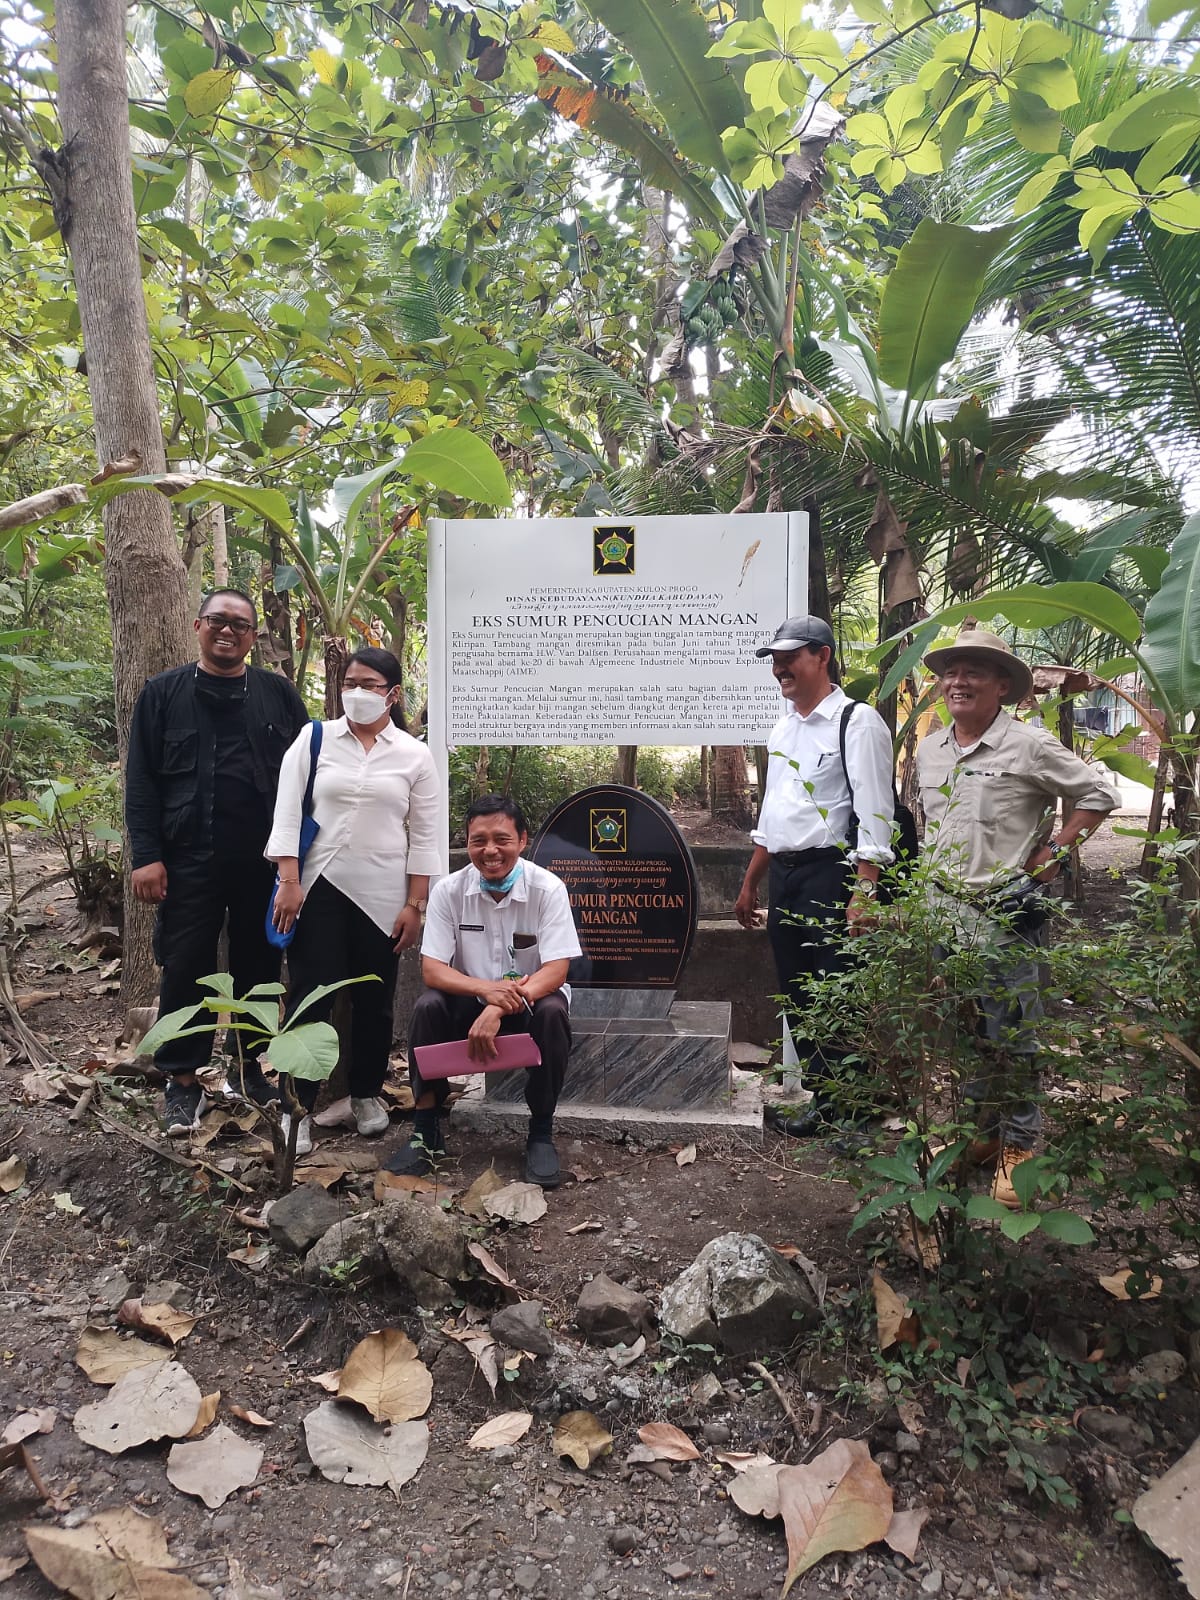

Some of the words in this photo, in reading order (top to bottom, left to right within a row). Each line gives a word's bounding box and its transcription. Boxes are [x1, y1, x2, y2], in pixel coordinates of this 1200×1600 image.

[472, 616, 502, 627] EKS
[507, 615, 568, 627] SUMUR
[573, 614, 673, 627] PENCUCIAN
[679, 613, 758, 626] MANGAN
[498, 631, 537, 639] Pencucian
[541, 631, 572, 640] Mangan
[576, 631, 621, 640] merupakan
[624, 630, 652, 639] bagian
[655, 630, 693, 639] tinggalan
[696, 630, 733, 639] tambang
[736, 631, 770, 639] mangan
[493, 640, 530, 650] Tambang
[536, 641, 569, 650] mangan
[628, 640, 647, 648] pada
[653, 639, 676, 647] bulan
[682, 639, 700, 648] Juni
[452, 650, 494, 659] pengusaha
[664, 648, 710, 657] mengalami
[452, 659, 470, 668] pada
[559, 658, 584, 666] bawah
[589, 658, 635, 667] Algemeene
[690, 658, 730, 667] Mijnbouw
[736, 657, 773, 667] Exploitat
[452, 668, 504, 677] Maatschappij
[550, 685, 582, 694] Mangan
[588, 685, 633, 694] merupakan
[689, 685, 716, 693] bagian
[722, 684, 748, 692] dalam
[754, 686, 780, 694] proses
[452, 695, 486, 703] produksi
[627, 694, 663, 703] tambang
[667, 695, 700, 703] mangan
[452, 704, 509, 713] meningkatkan
[538, 704, 551, 713] biji
[554, 704, 587, 713] mangan
[591, 703, 625, 711] sebelum
[629, 703, 665, 712] diangkut
[669, 703, 699, 712] dengan
[732, 703, 744, 712] api
[680, 712, 714, 722] Mangan
[732, 712, 780, 722] merupakan
[514, 722, 545, 731] bergaya
[569, 723, 589, 731] yang
[452, 731, 477, 739] proses
[479, 731, 513, 740] produksi
[542, 731, 578, 740] tambang
[581, 731, 616, 740] mangan.
[570, 894, 607, 907] UMUR
[610, 894, 684, 908] PENCUCIAN
[581, 911, 637, 924] MANGAN
